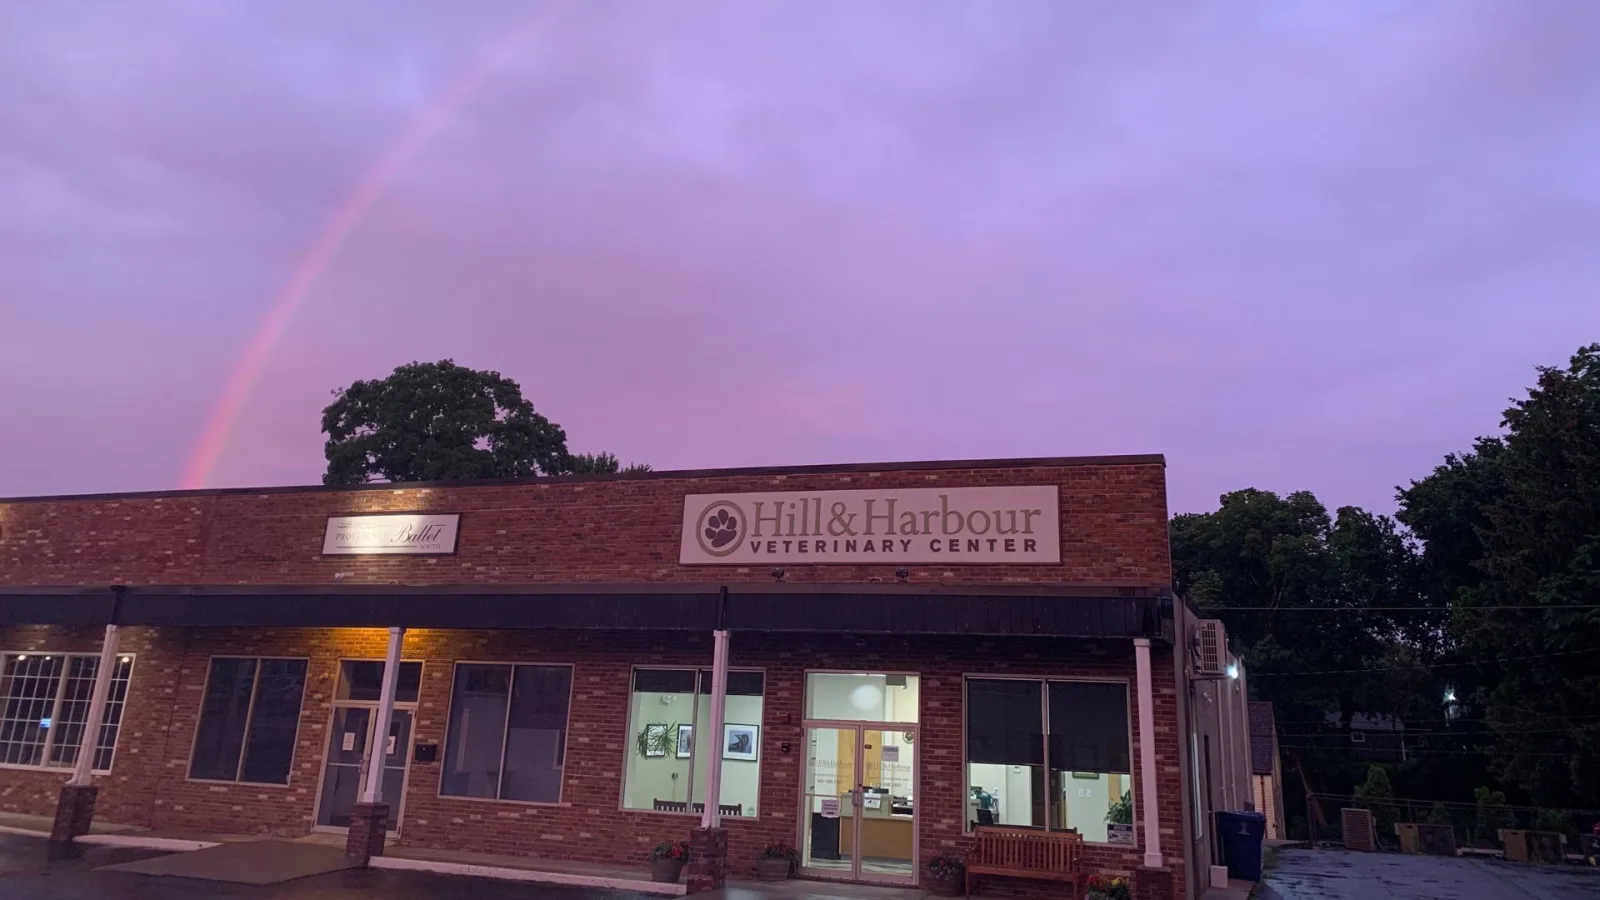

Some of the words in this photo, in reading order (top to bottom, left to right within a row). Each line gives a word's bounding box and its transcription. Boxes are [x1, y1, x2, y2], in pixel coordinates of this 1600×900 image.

[391, 520, 442, 543] Ballet
[750, 539, 912, 554] VETERINARY
[929, 538, 1038, 553] CENTER
